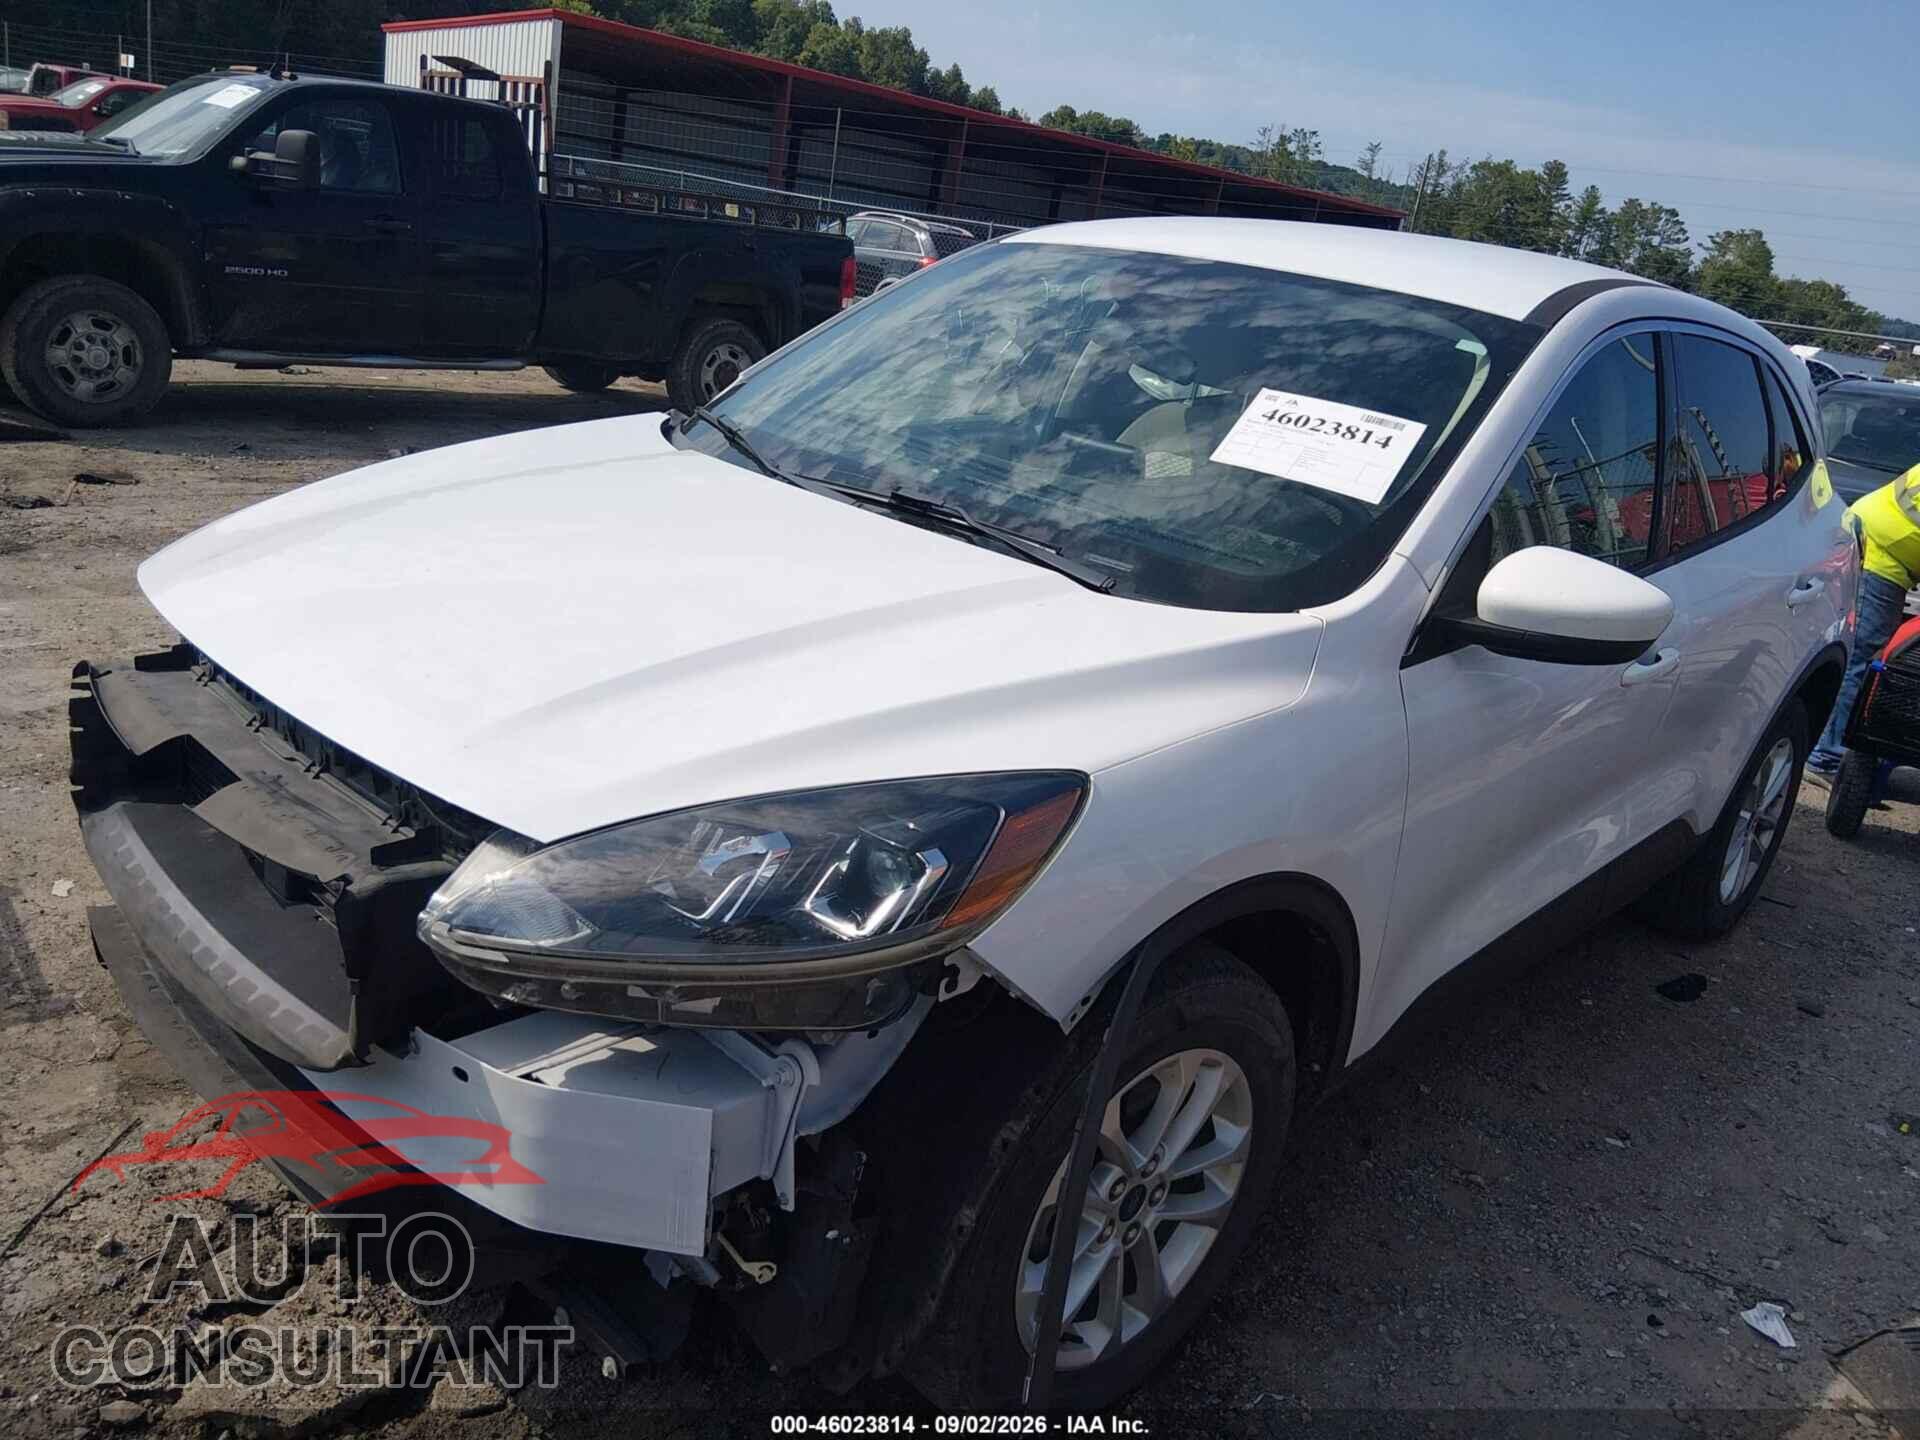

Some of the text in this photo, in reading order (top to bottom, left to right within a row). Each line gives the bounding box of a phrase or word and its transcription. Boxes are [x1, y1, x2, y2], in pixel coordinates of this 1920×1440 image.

[224, 265, 288, 277] 2500 HD
[1261, 408, 1394, 449] 46023814
